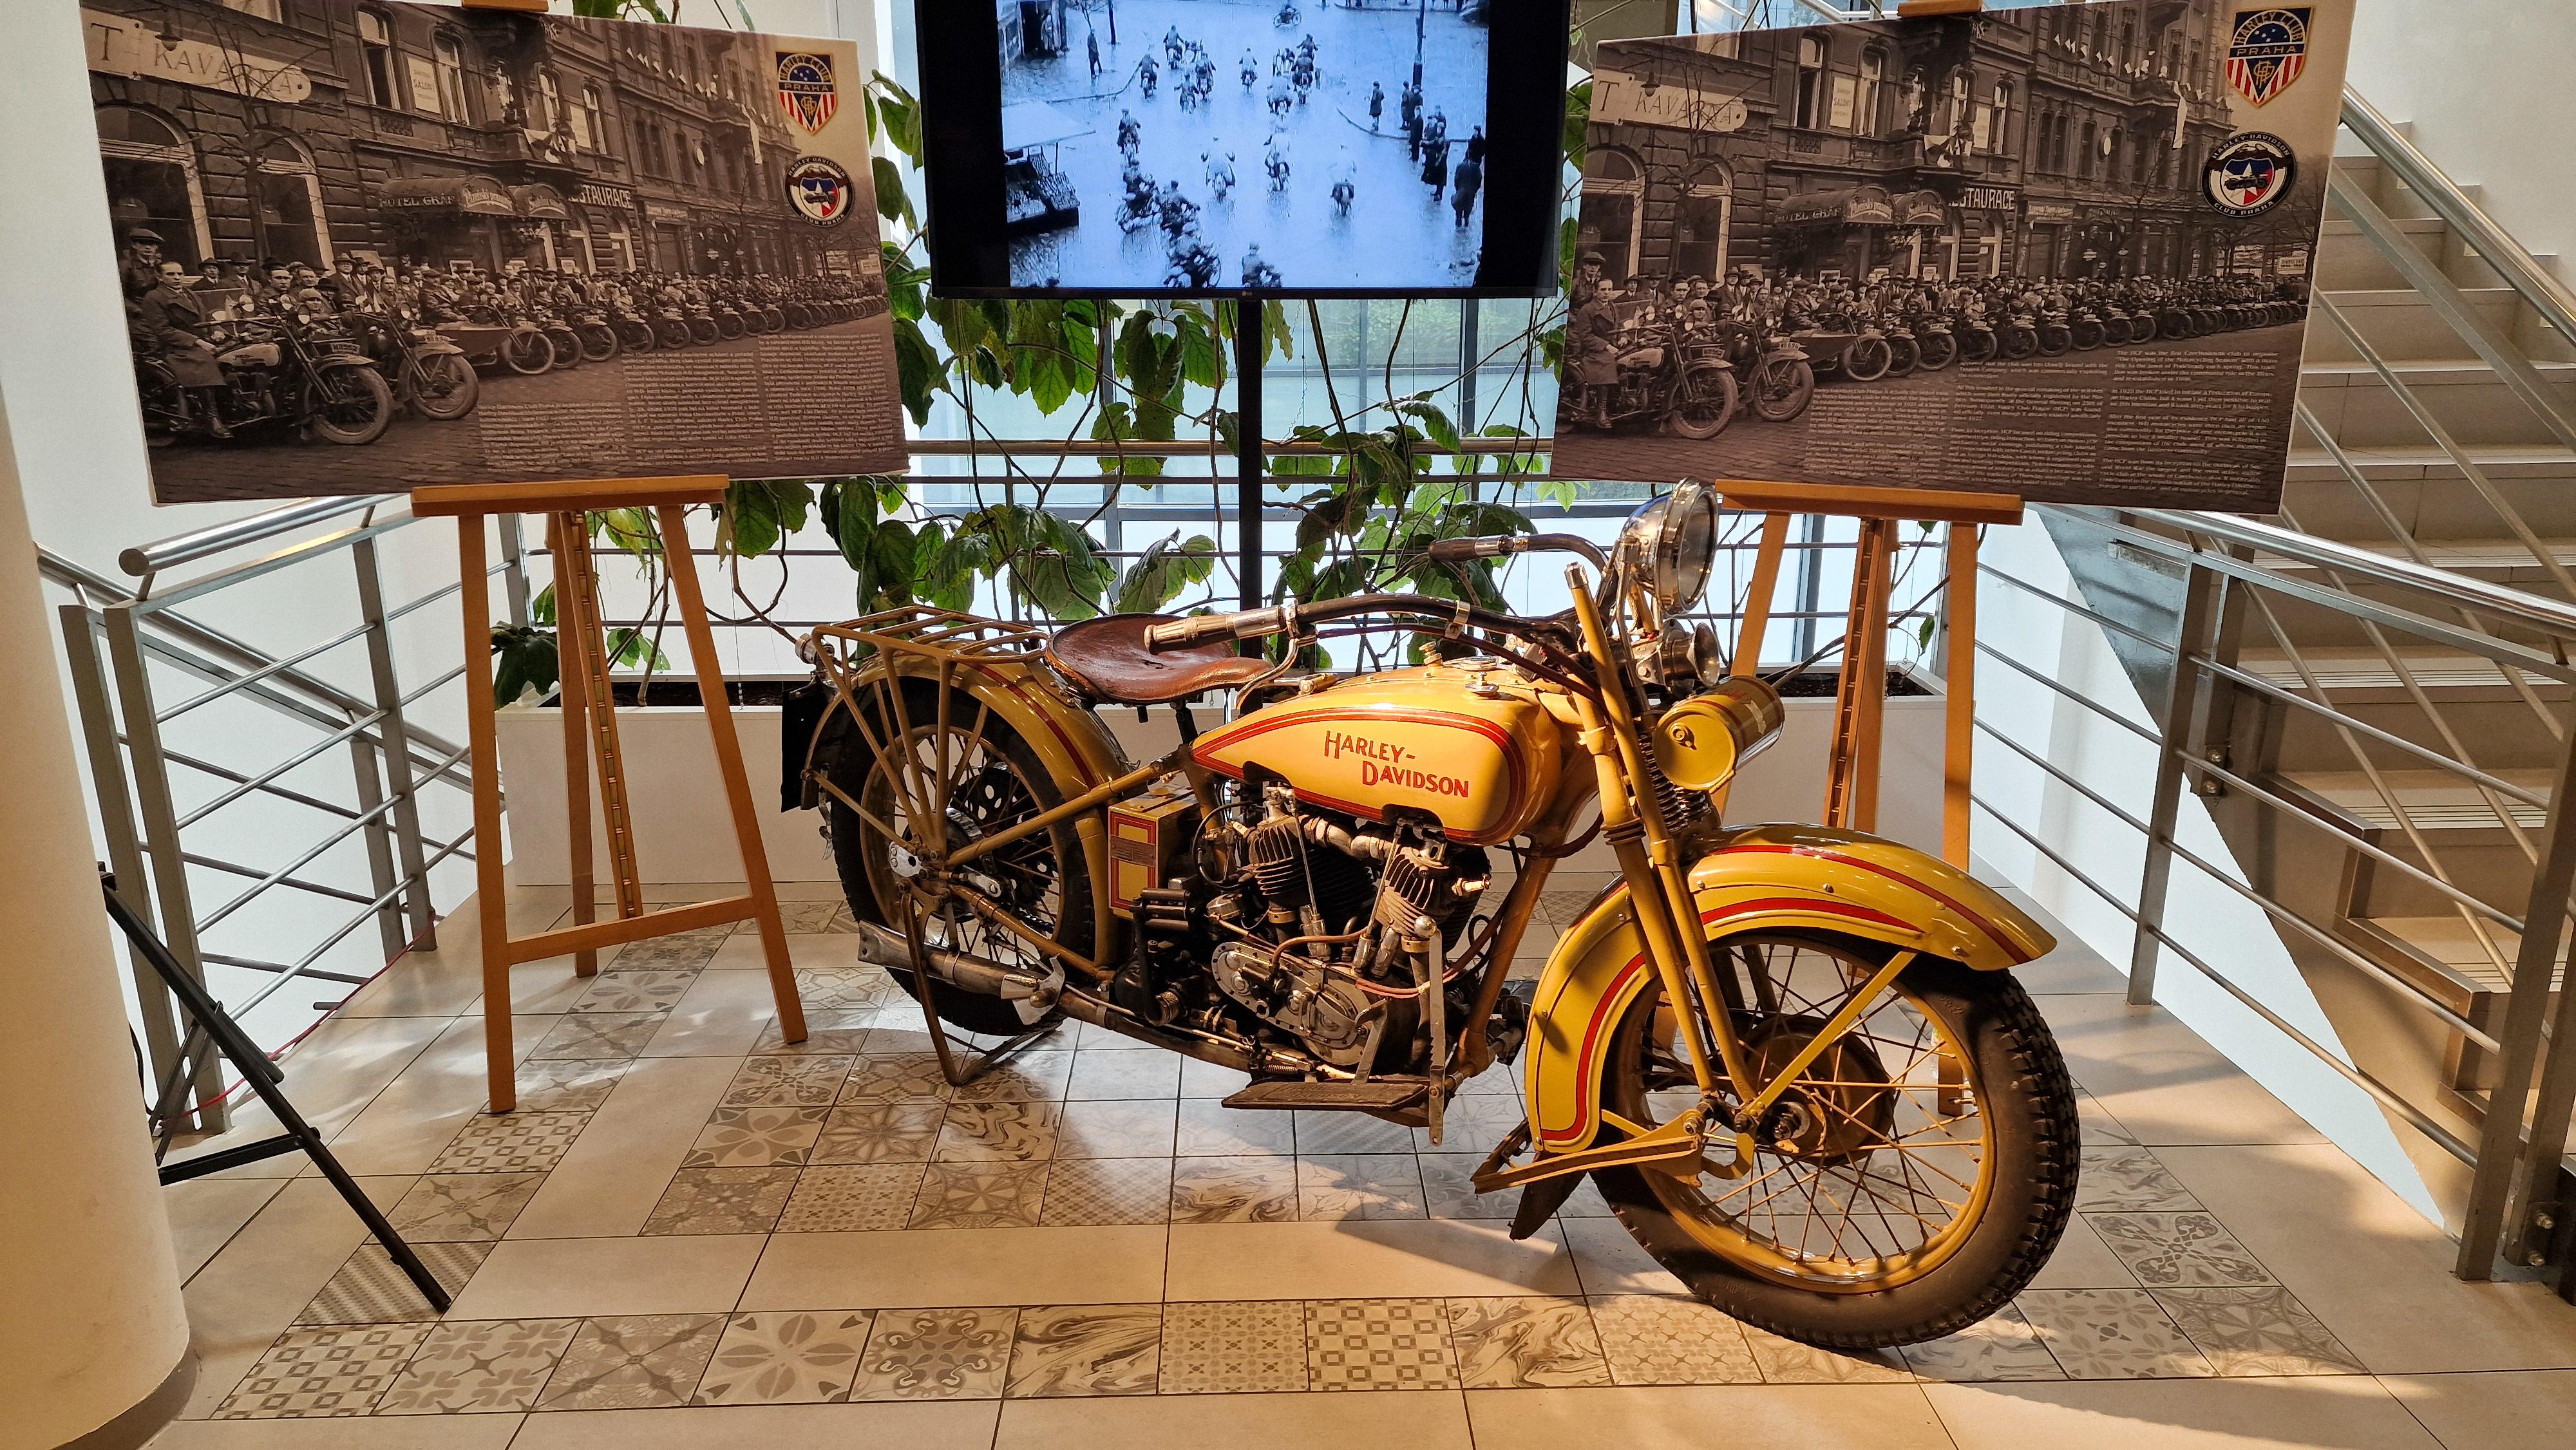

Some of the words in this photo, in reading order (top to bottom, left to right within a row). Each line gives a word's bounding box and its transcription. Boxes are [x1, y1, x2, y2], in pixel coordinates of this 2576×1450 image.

[2235, 12, 2276, 46] HARLEY
[90, 23, 123, 61] T
[2237, 46, 2297, 56] PRAHA
[780, 56, 805, 80] HARLEY
[784, 83, 829, 92] PRAHA
[1598, 80, 1620, 111] T
[800, 213, 820, 225] CLUB
[2214, 202, 2237, 215] CLUB
[2240, 201, 2275, 216] PRAHA
[1362, 760, 1469, 798] DAVIDSON
